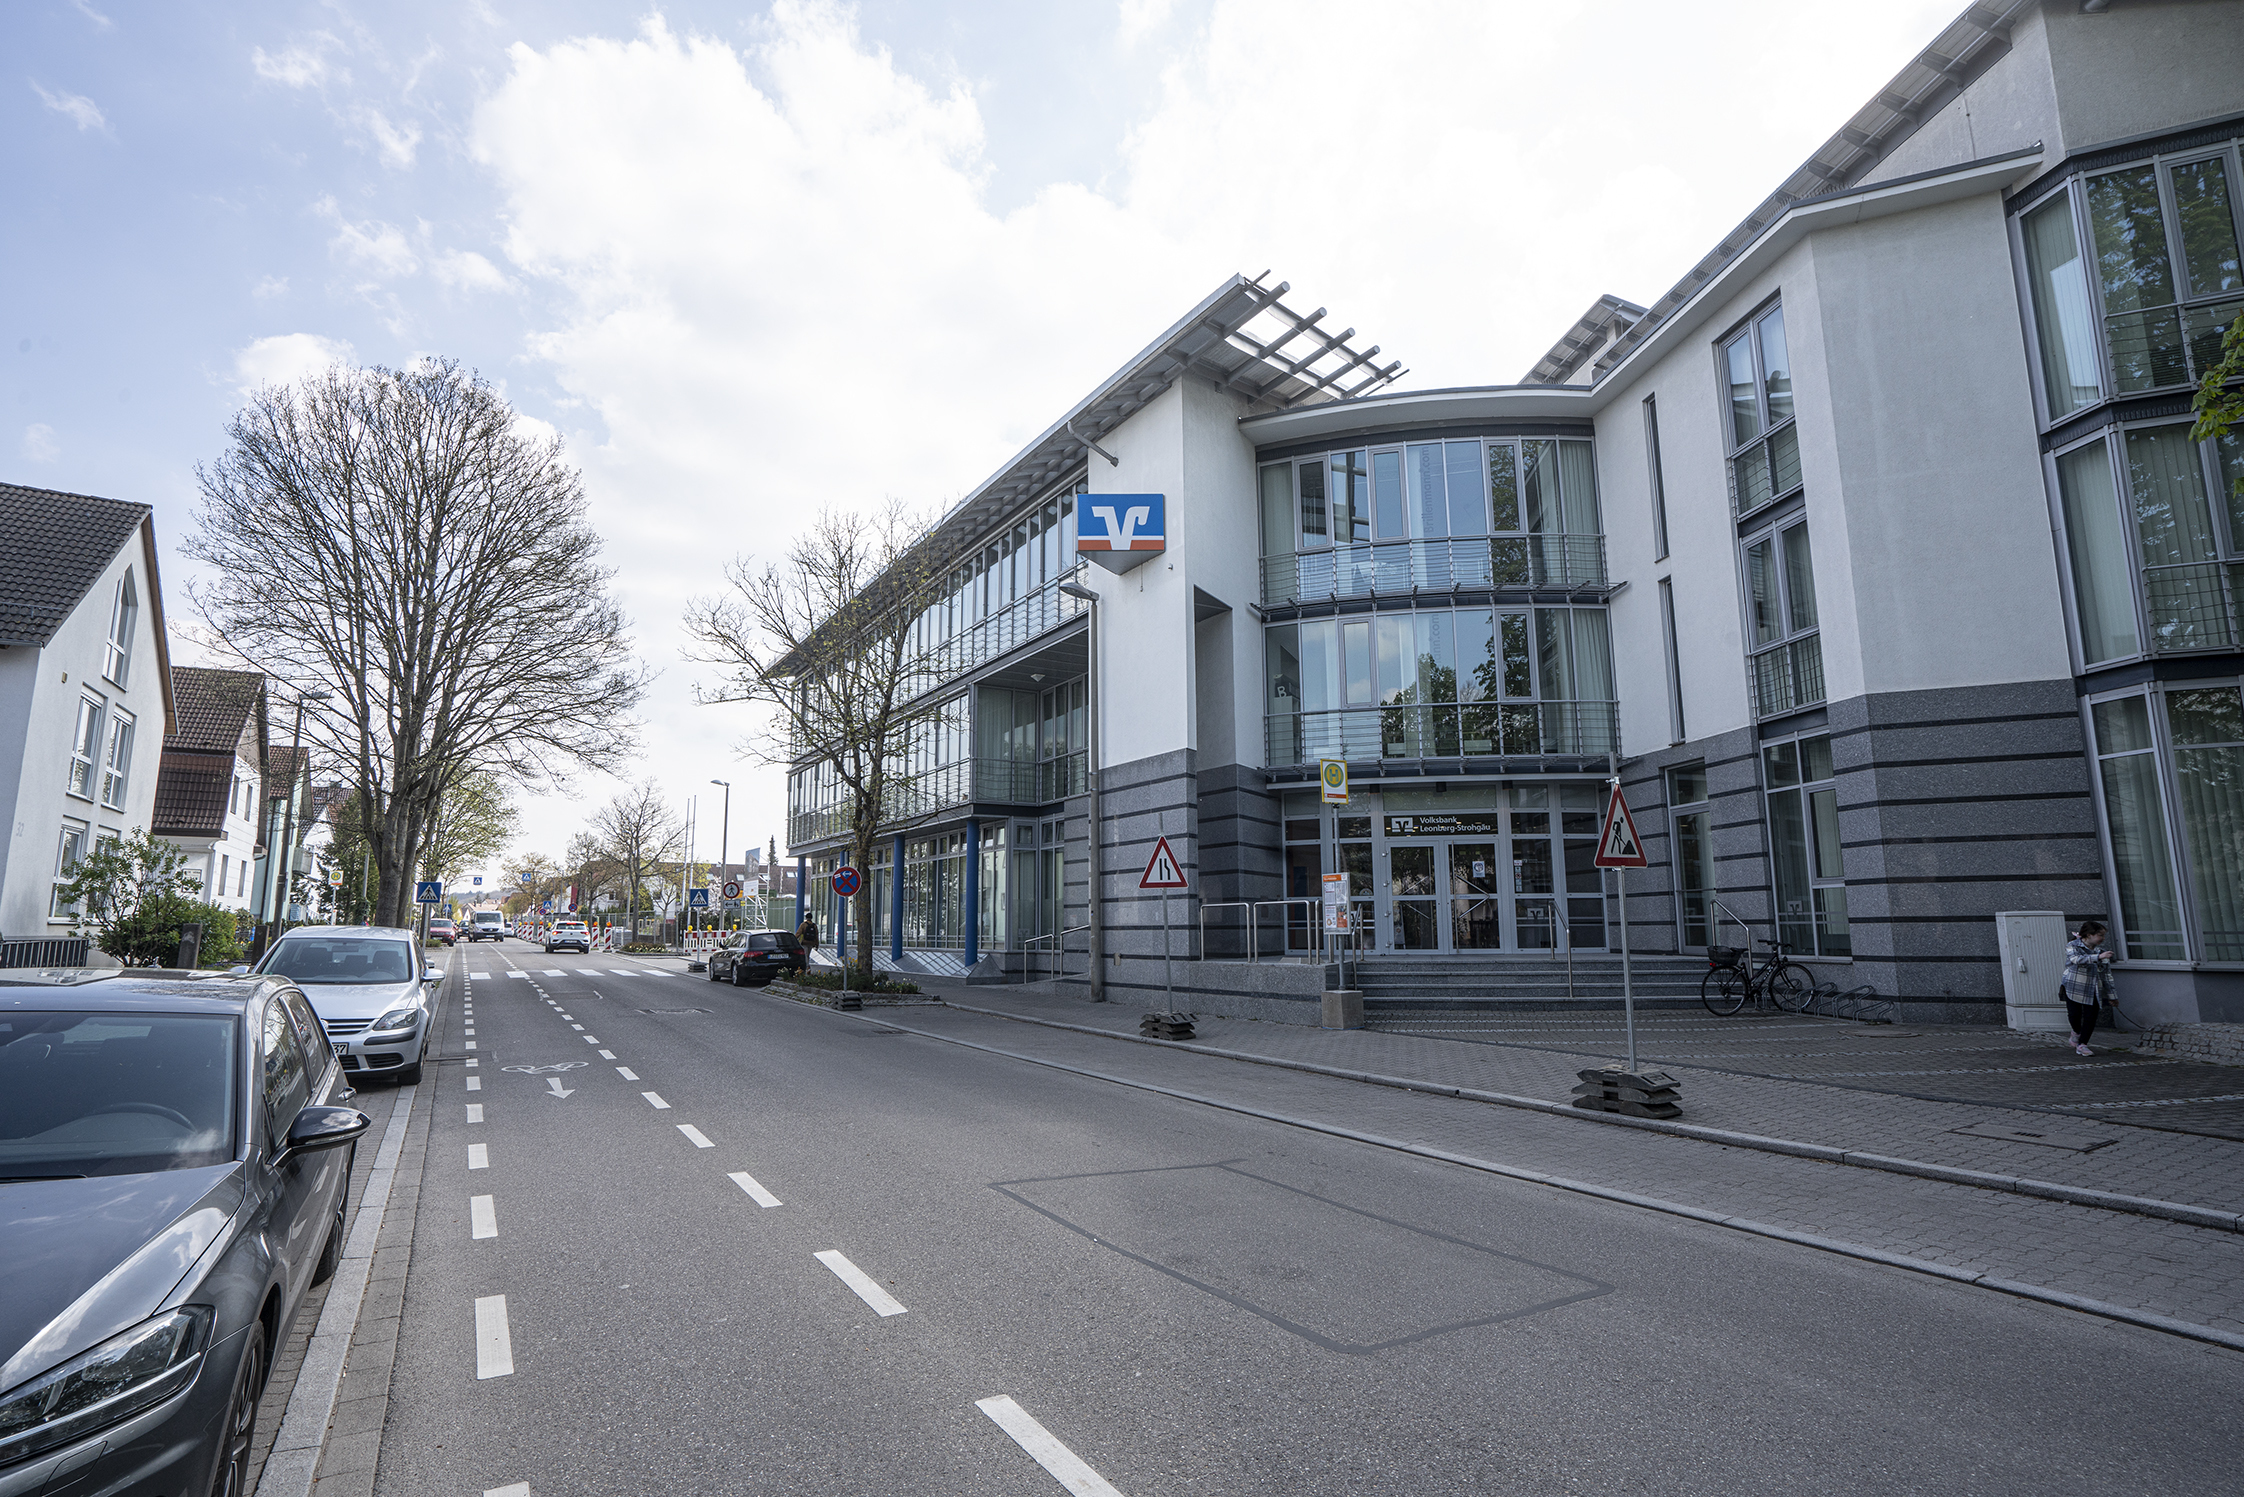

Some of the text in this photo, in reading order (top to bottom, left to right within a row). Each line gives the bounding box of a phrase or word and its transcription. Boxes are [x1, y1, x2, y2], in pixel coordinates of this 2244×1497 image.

[1329, 768, 1340, 782] H
[1420, 816, 1458, 824] Volksbank
[16, 821, 24, 837] 32
[1420, 824, 1491, 834] Leonberg-Strohgäu
